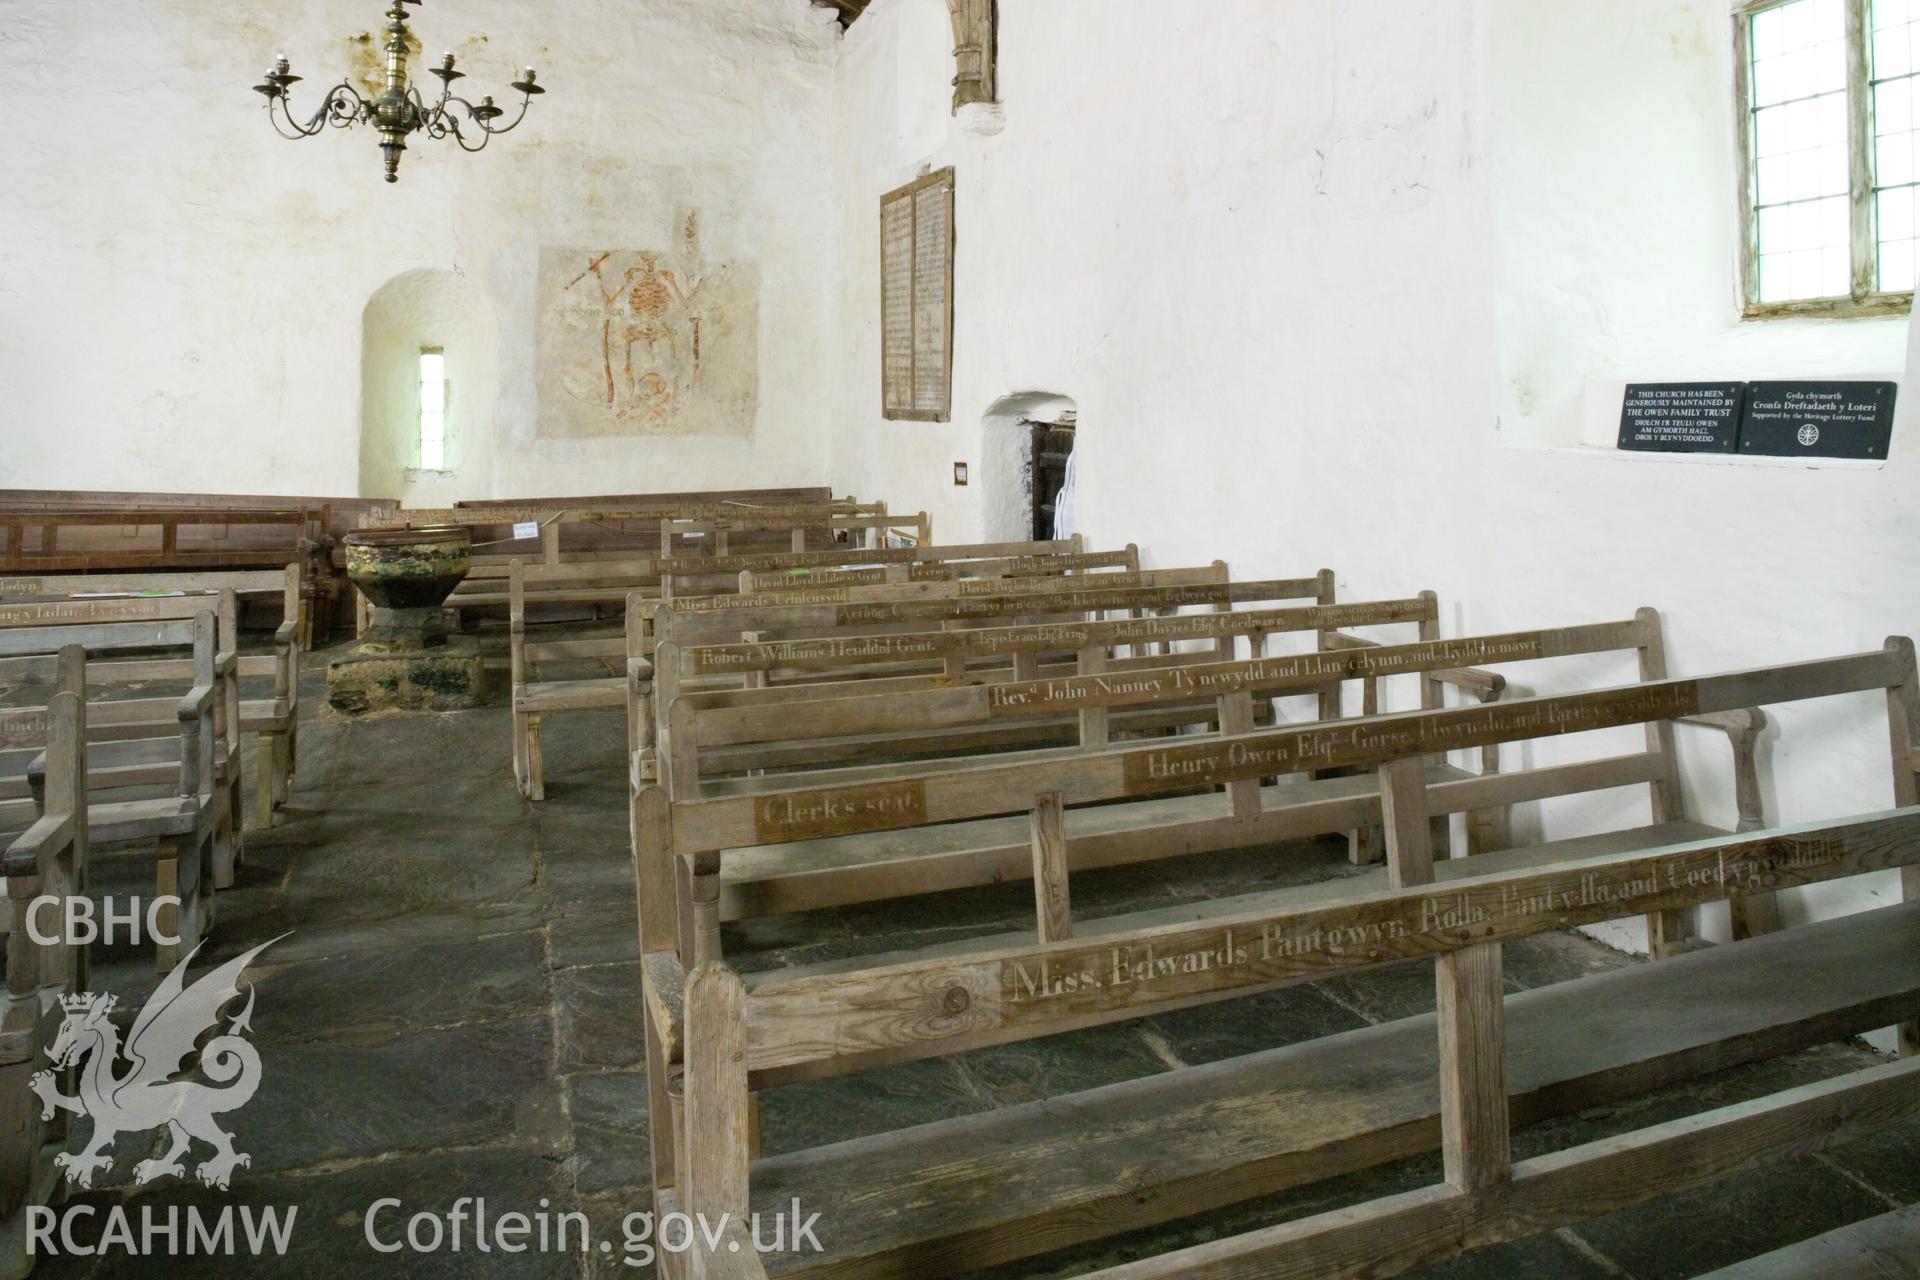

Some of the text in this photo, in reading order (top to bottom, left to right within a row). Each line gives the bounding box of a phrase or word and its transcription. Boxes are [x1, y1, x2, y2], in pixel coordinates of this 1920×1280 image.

[1786, 391, 1842, 402] Gyda chymorth
[1627, 408, 1732, 416] THE OWEN FAMILY TRUST
[1753, 401, 1876, 413] Cronfa Dreftadaeth y Loteri
[1751, 412, 1782, 420] Supported
[1783, 412, 1791, 420] by
[1804, 413, 1831, 421] Heritage
[1832, 414, 1856, 422] Lottery
[1660, 434, 1714, 442] BLYNYDDOEDD
[713, 595, 768, 608] Edwards
[1112, 622, 1143, 637] John
[701, 648, 752, 665] Robert
[759, 643, 825, 662] Williams
[1043, 679, 1088, 701] John
[1096, 675, 1163, 698] Nanney
[1148, 752, 1220, 781] Henry
[1228, 742, 1288, 767] Owen
[763, 791, 856, 825] Clerk's
[1111, 928, 1249, 986] Edwards
